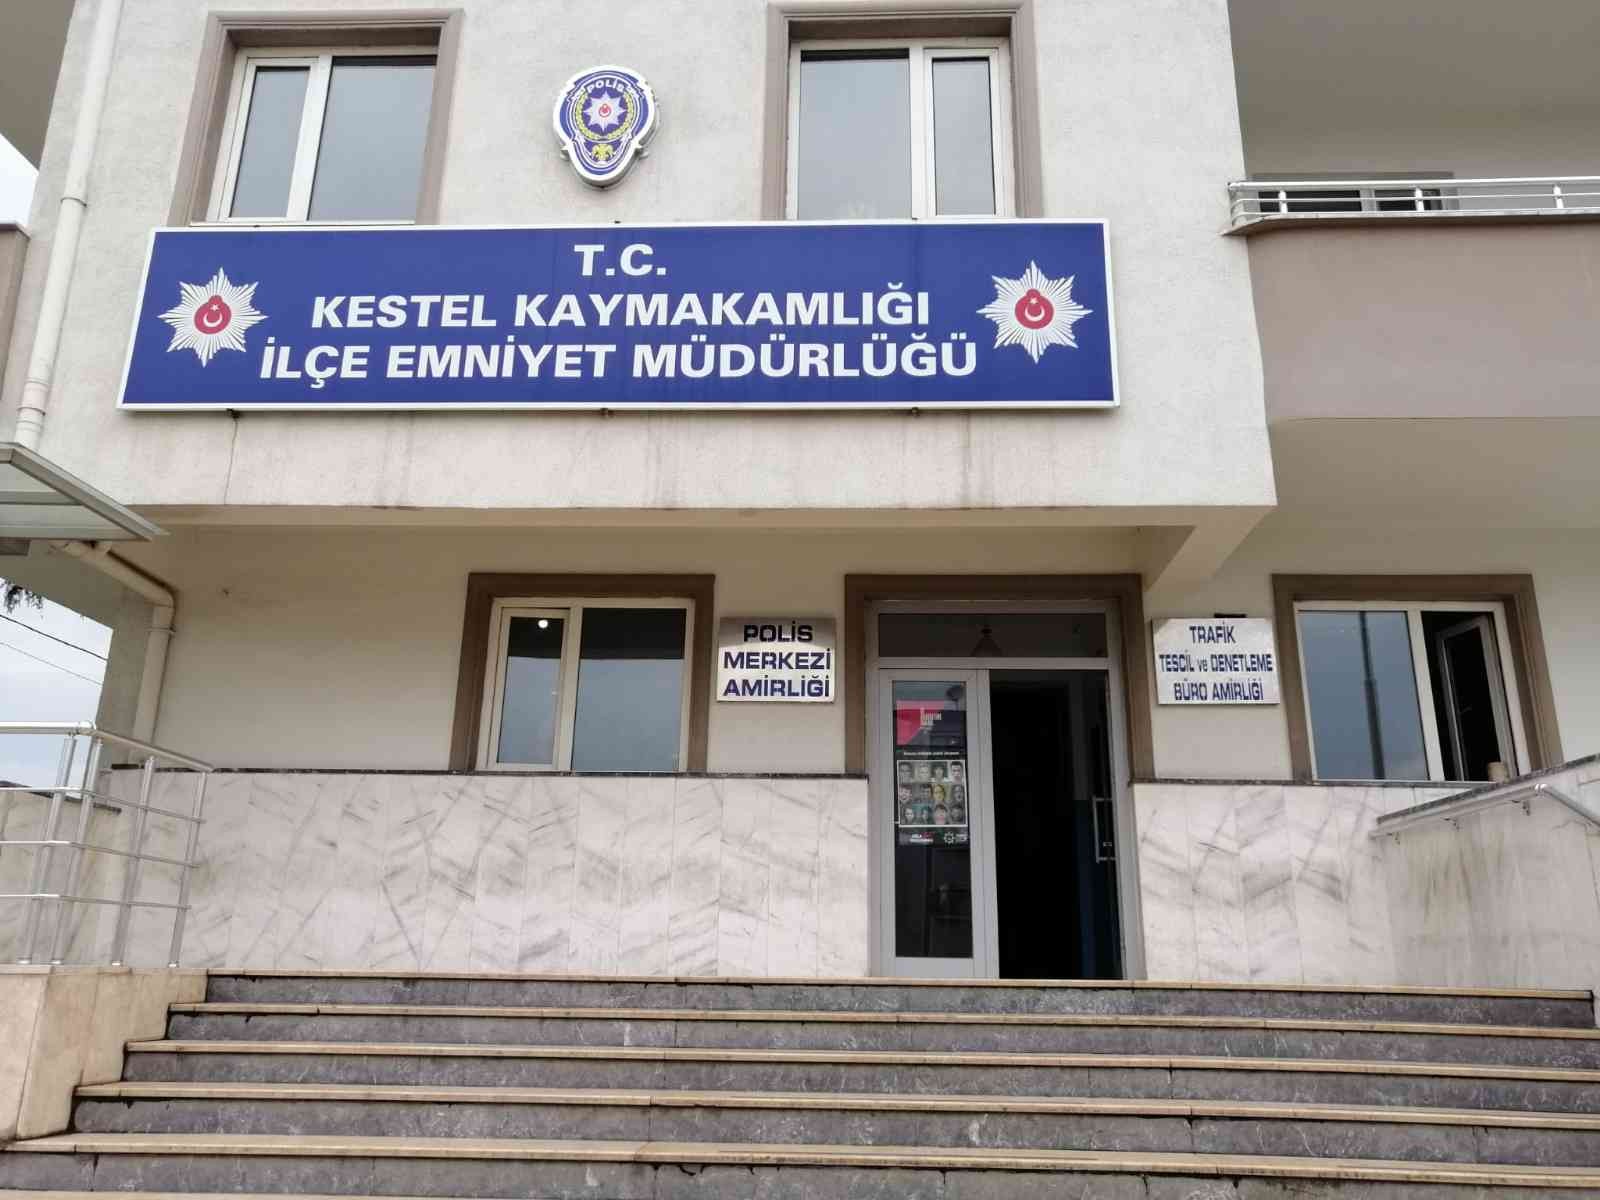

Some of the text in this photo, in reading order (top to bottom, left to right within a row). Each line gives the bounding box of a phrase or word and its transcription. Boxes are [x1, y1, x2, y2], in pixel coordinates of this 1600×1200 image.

[586, 78, 626, 94] POLİS
[573, 243, 668, 276] T.C.
[311, 282, 930, 328] KESTEL KAYMAKAMLIĞI
[260, 332, 978, 389] İLÇE EMNİYET MÜDÜRLÜĞÜ
[743, 620, 813, 643] POLİS
[1189, 621, 1236, 644] TRAFİK
[723, 648, 831, 670] MERKEZİ
[1159, 649, 1273, 673] TESCİL ve DENETLEME
[722, 674, 830, 698] AMİRLİĞİ
[1173, 677, 1264, 701] BÜRO AMİRLİĞİ
